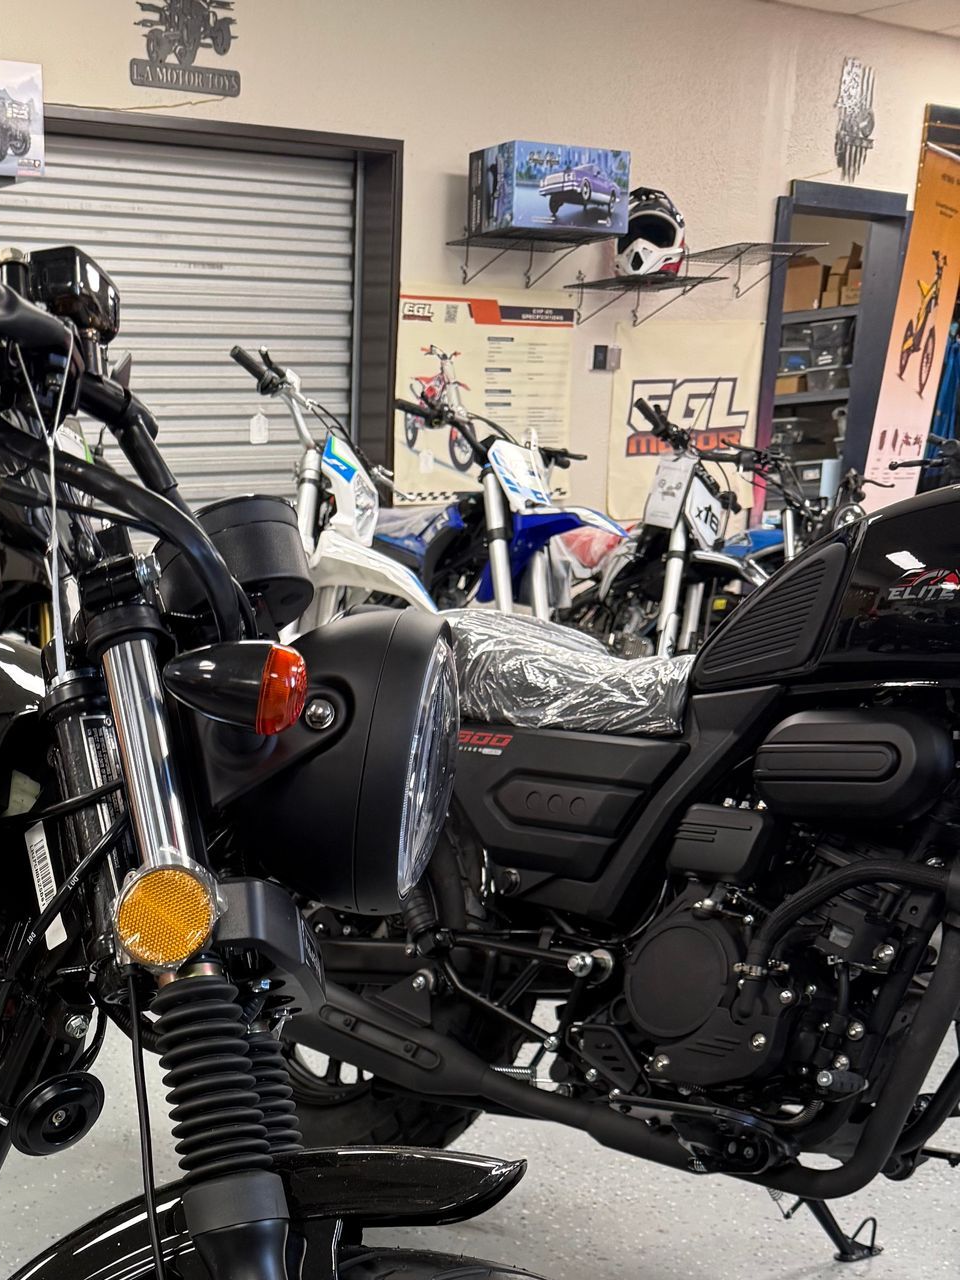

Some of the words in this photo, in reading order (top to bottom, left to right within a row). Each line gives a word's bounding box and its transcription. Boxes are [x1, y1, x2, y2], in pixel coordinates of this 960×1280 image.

[157, 67, 203, 88] MOTOR
[206, 73, 239, 90] TOYS
[403, 302, 433, 316] EGL
[627, 377, 749, 433] EGL
[888, 585, 955, 601] ELITE
